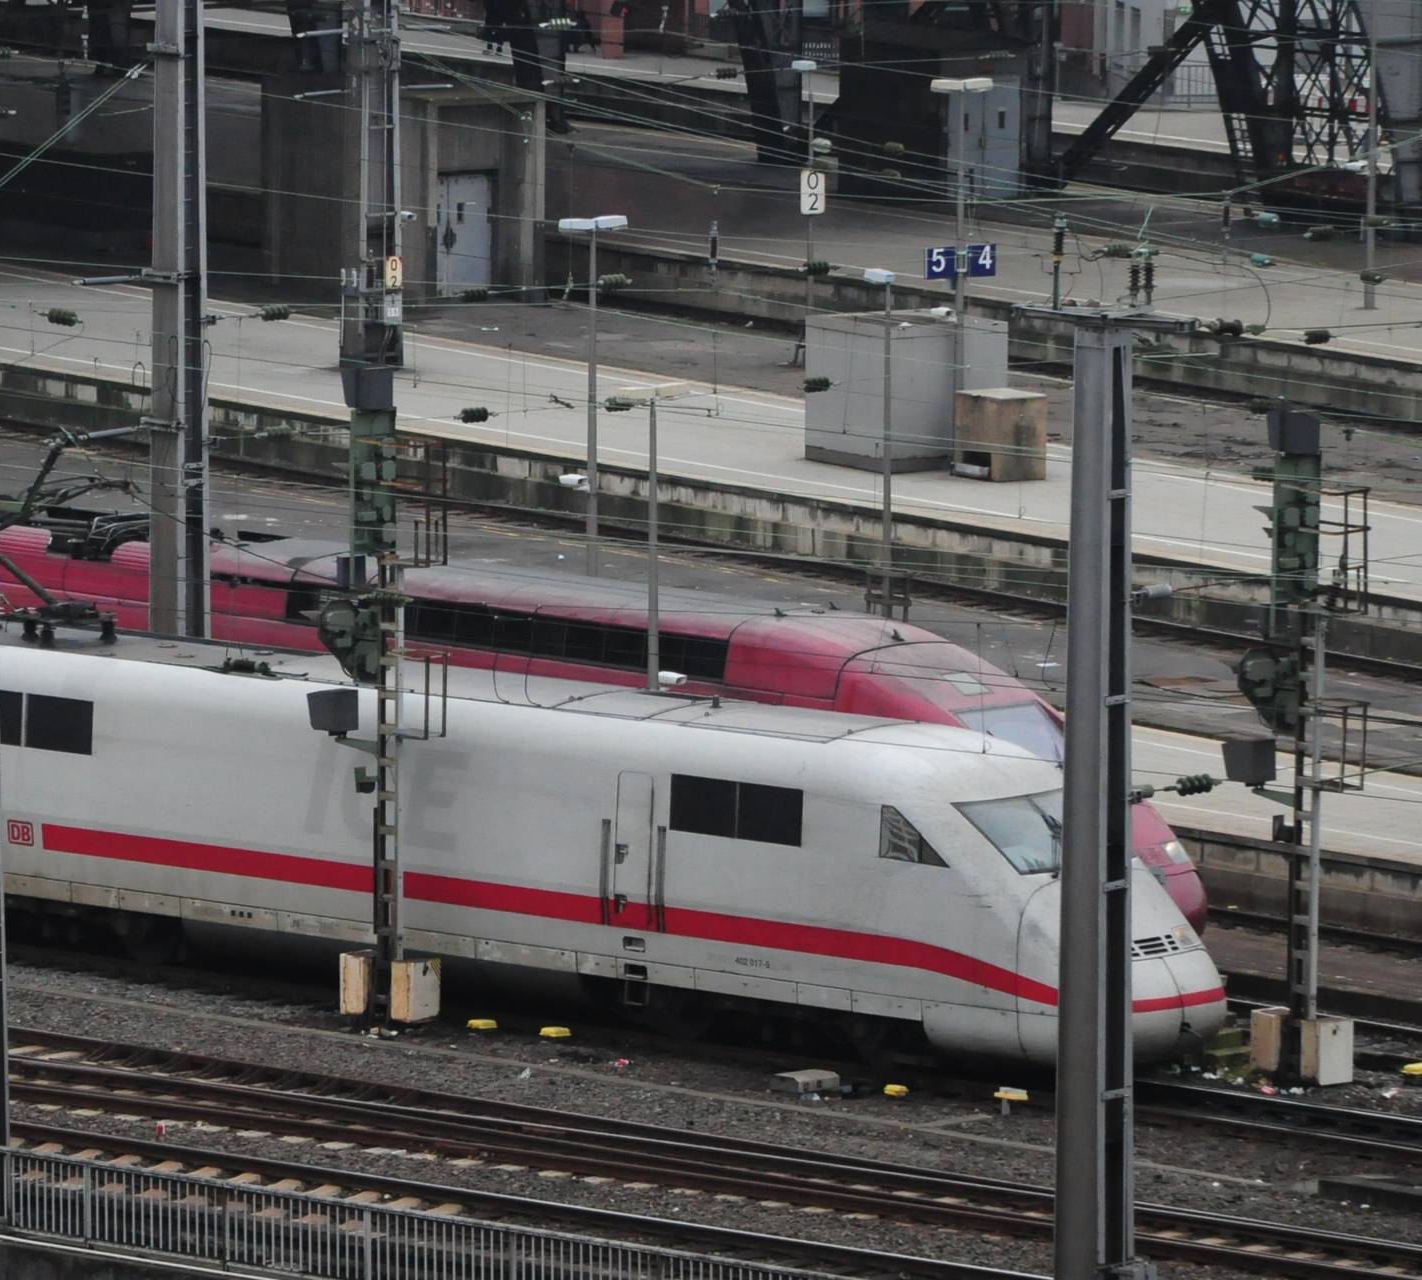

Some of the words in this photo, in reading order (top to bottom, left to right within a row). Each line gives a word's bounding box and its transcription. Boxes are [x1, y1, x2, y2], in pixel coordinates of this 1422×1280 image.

[807, 172, 819, 190] 0
[808, 193, 819, 211] 2
[390, 258, 398, 272] 0
[931, 248, 946, 273] 5
[978, 245, 993, 270] 4
[390, 275, 398, 288] 2
[10, 823, 31, 842] DB
